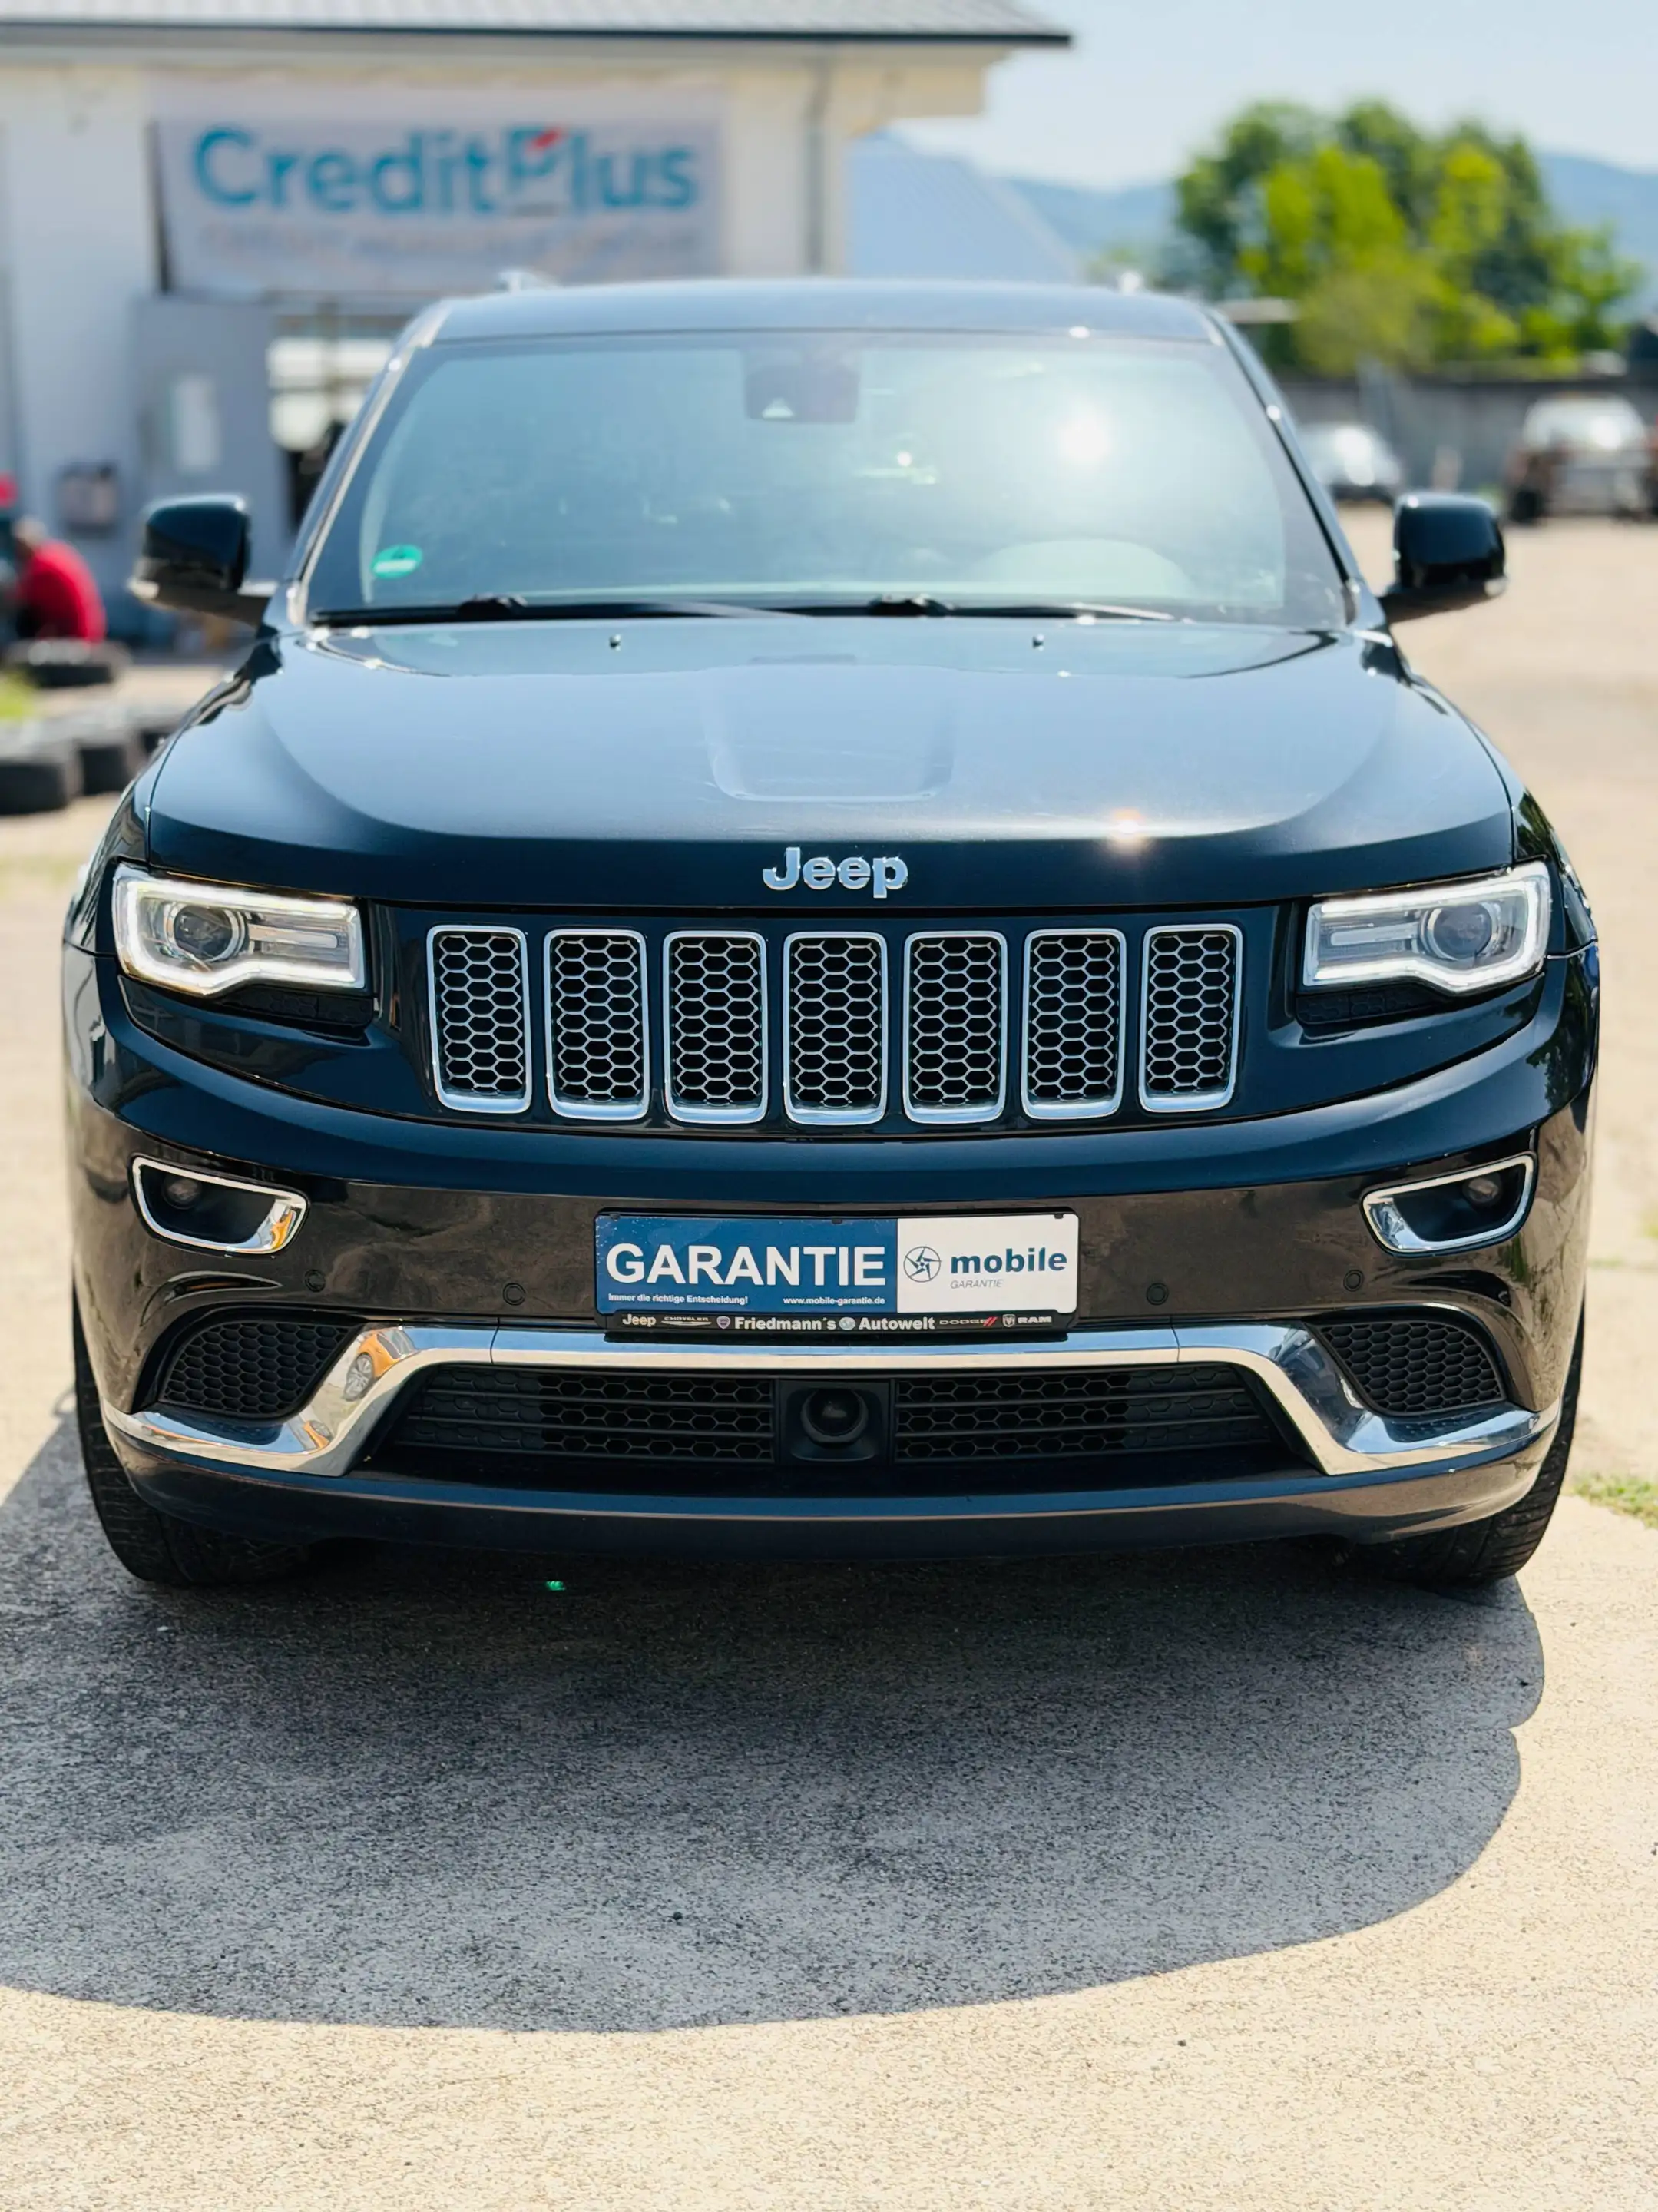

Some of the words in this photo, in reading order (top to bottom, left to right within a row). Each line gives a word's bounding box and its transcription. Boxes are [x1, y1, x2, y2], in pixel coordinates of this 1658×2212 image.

[192, 123, 700, 217] CreditPlus
[763, 846, 908, 899] Jeep
[606, 1243, 886, 1286] GARANTIE
[950, 1247, 1068, 1275] mobile
[949, 1278, 1004, 1290] GARANTIE
[607, 1293, 636, 1303] Immer
[637, 1293, 650, 1303] die
[653, 1293, 685, 1305] richtige
[687, 1294, 749, 1306] Entscheidung!
[783, 1296, 886, 1306] www.mobile-garantie.de
[622, 1313, 657, 1328] Jeep
[858, 1316, 936, 1330] Autowelt
